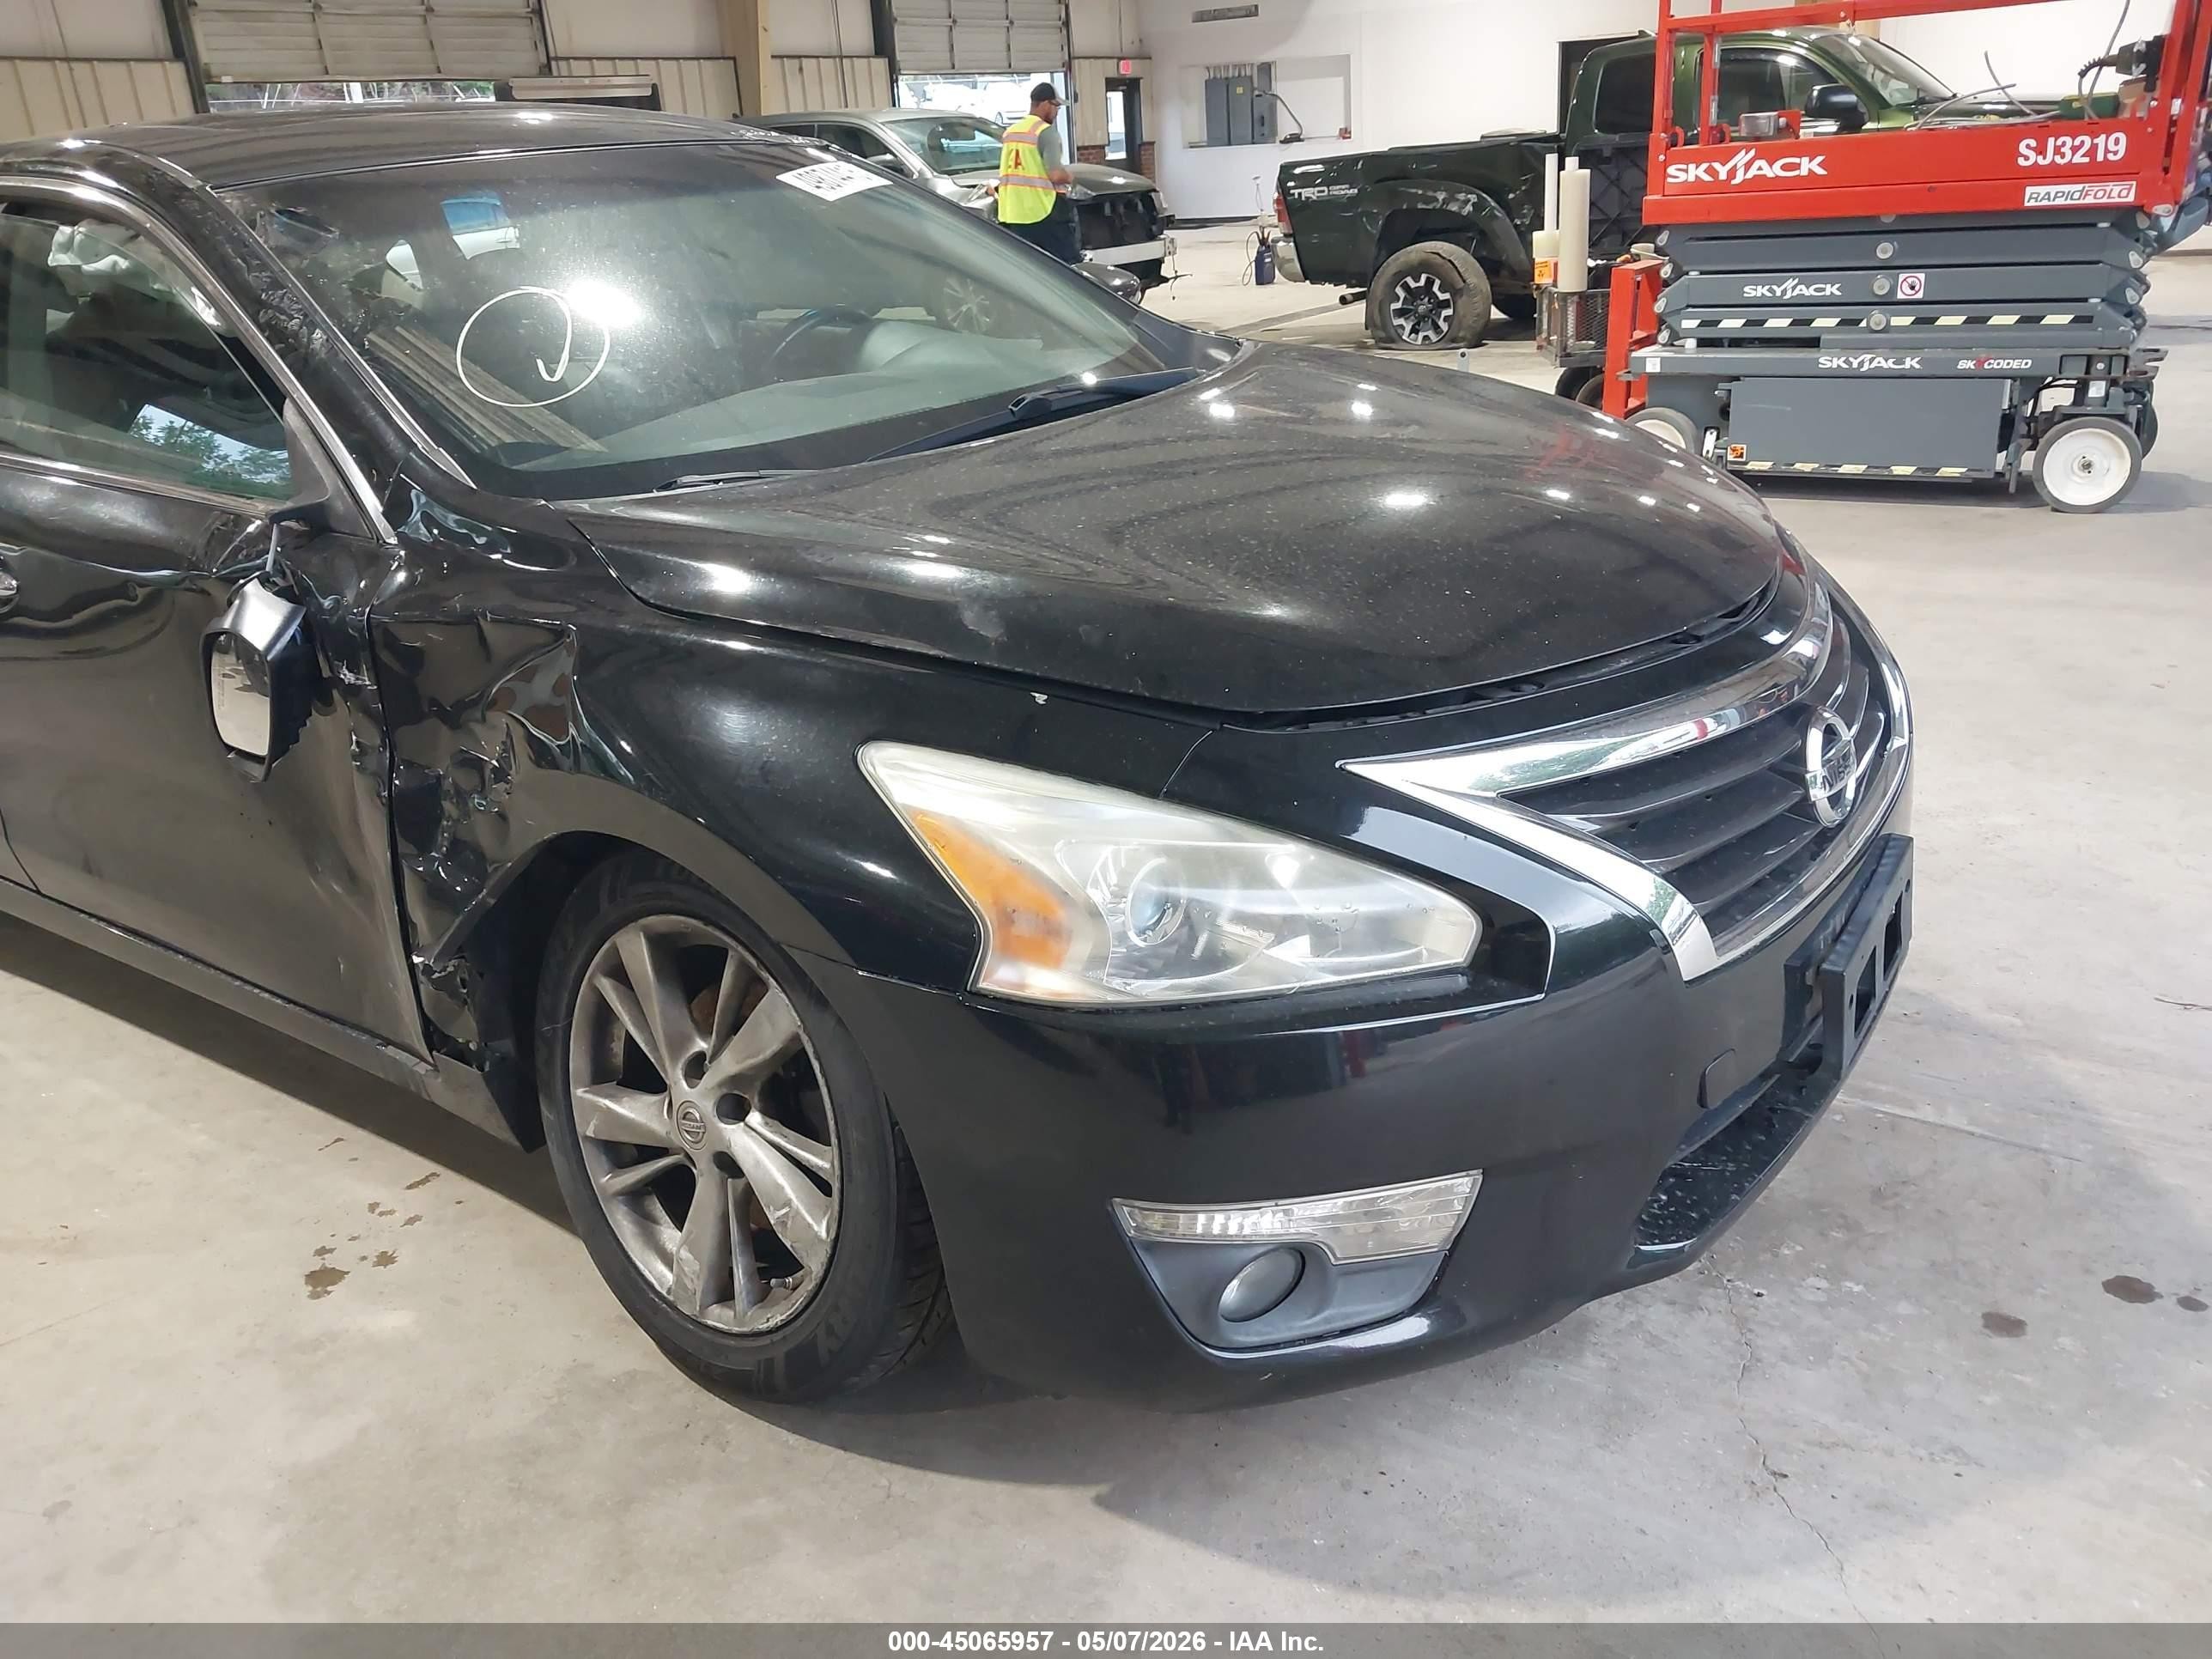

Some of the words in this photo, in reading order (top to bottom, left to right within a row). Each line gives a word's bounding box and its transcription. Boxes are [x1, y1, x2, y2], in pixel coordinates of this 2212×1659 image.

[2017, 131, 2127, 167] SJ3219
[1666, 148, 1828, 185] SKYJACK
[1290, 186, 1328, 200] TRD
[1743, 277, 1842, 300] SKYJACK
[1818, 354, 1923, 372] SKYJACK
